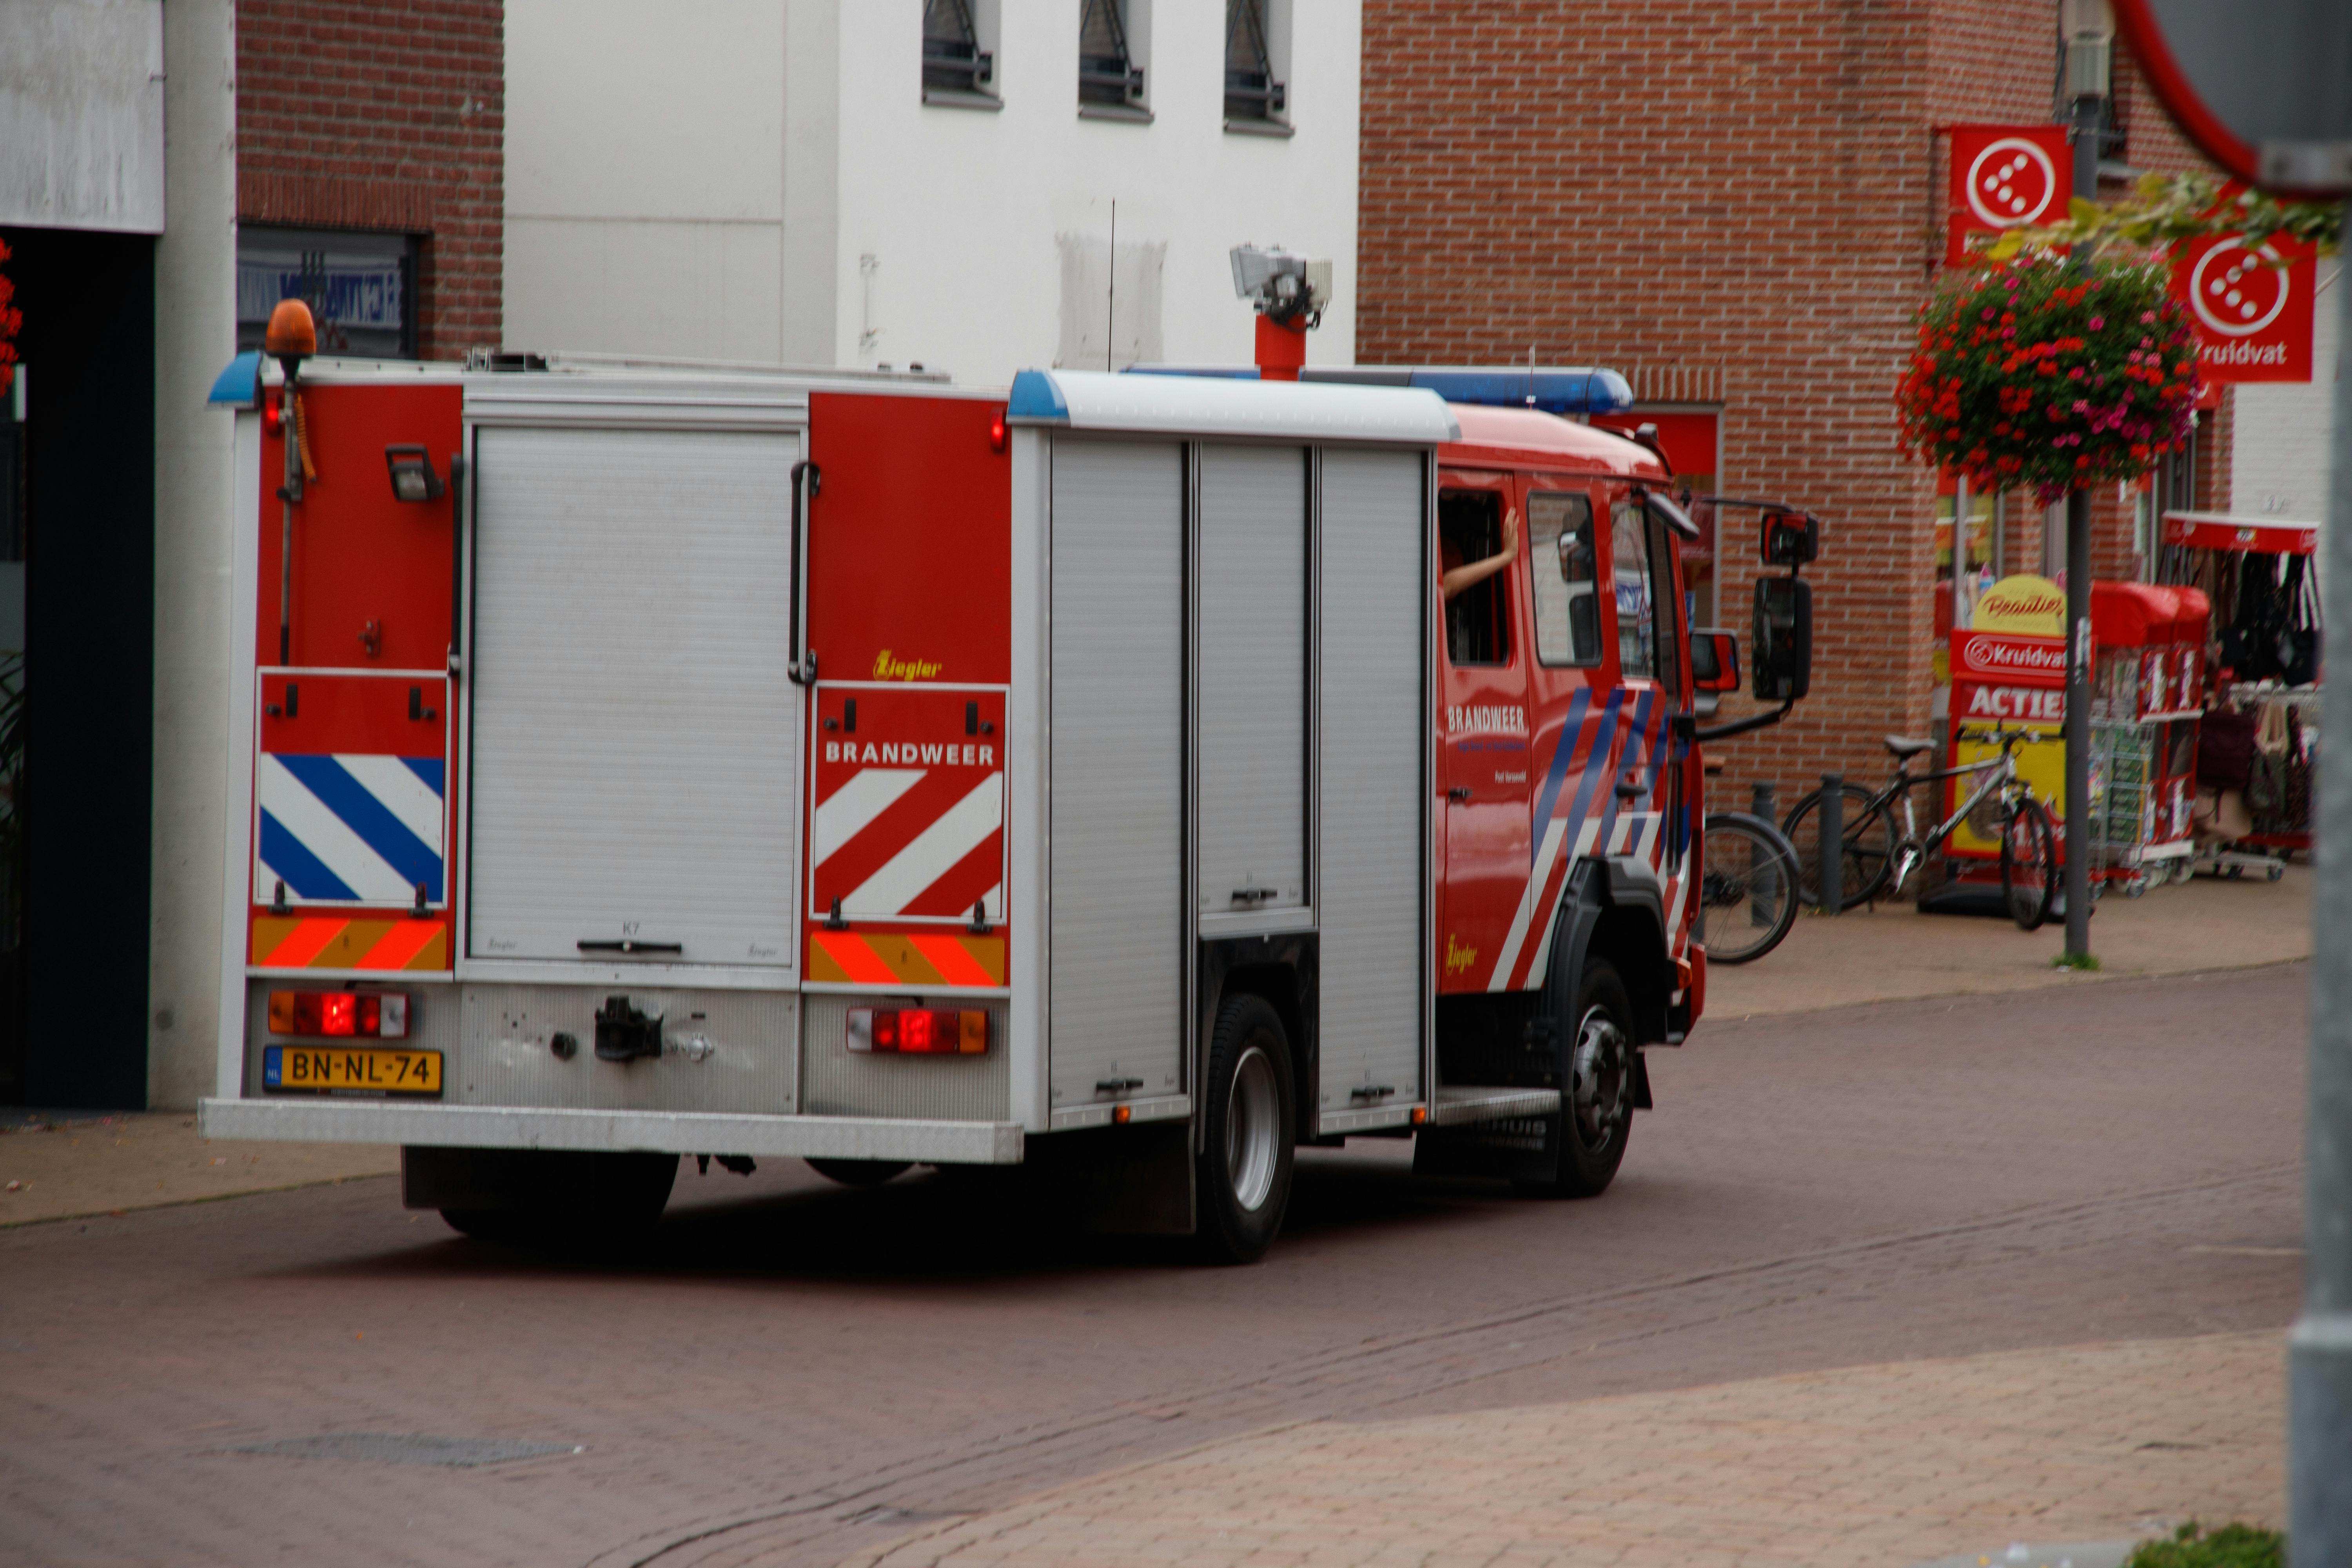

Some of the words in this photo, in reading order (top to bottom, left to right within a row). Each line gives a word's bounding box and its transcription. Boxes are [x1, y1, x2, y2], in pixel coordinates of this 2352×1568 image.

[1968, 685, 2068, 719] ACTIE
[1448, 704, 1525, 734] BRANDWEER
[826, 741, 994, 766] BRANDWEER
[622, 921, 640, 936] K7
[267, 1068, 279, 1081] NL
[292, 1051, 430, 1085] BN-NL-74
